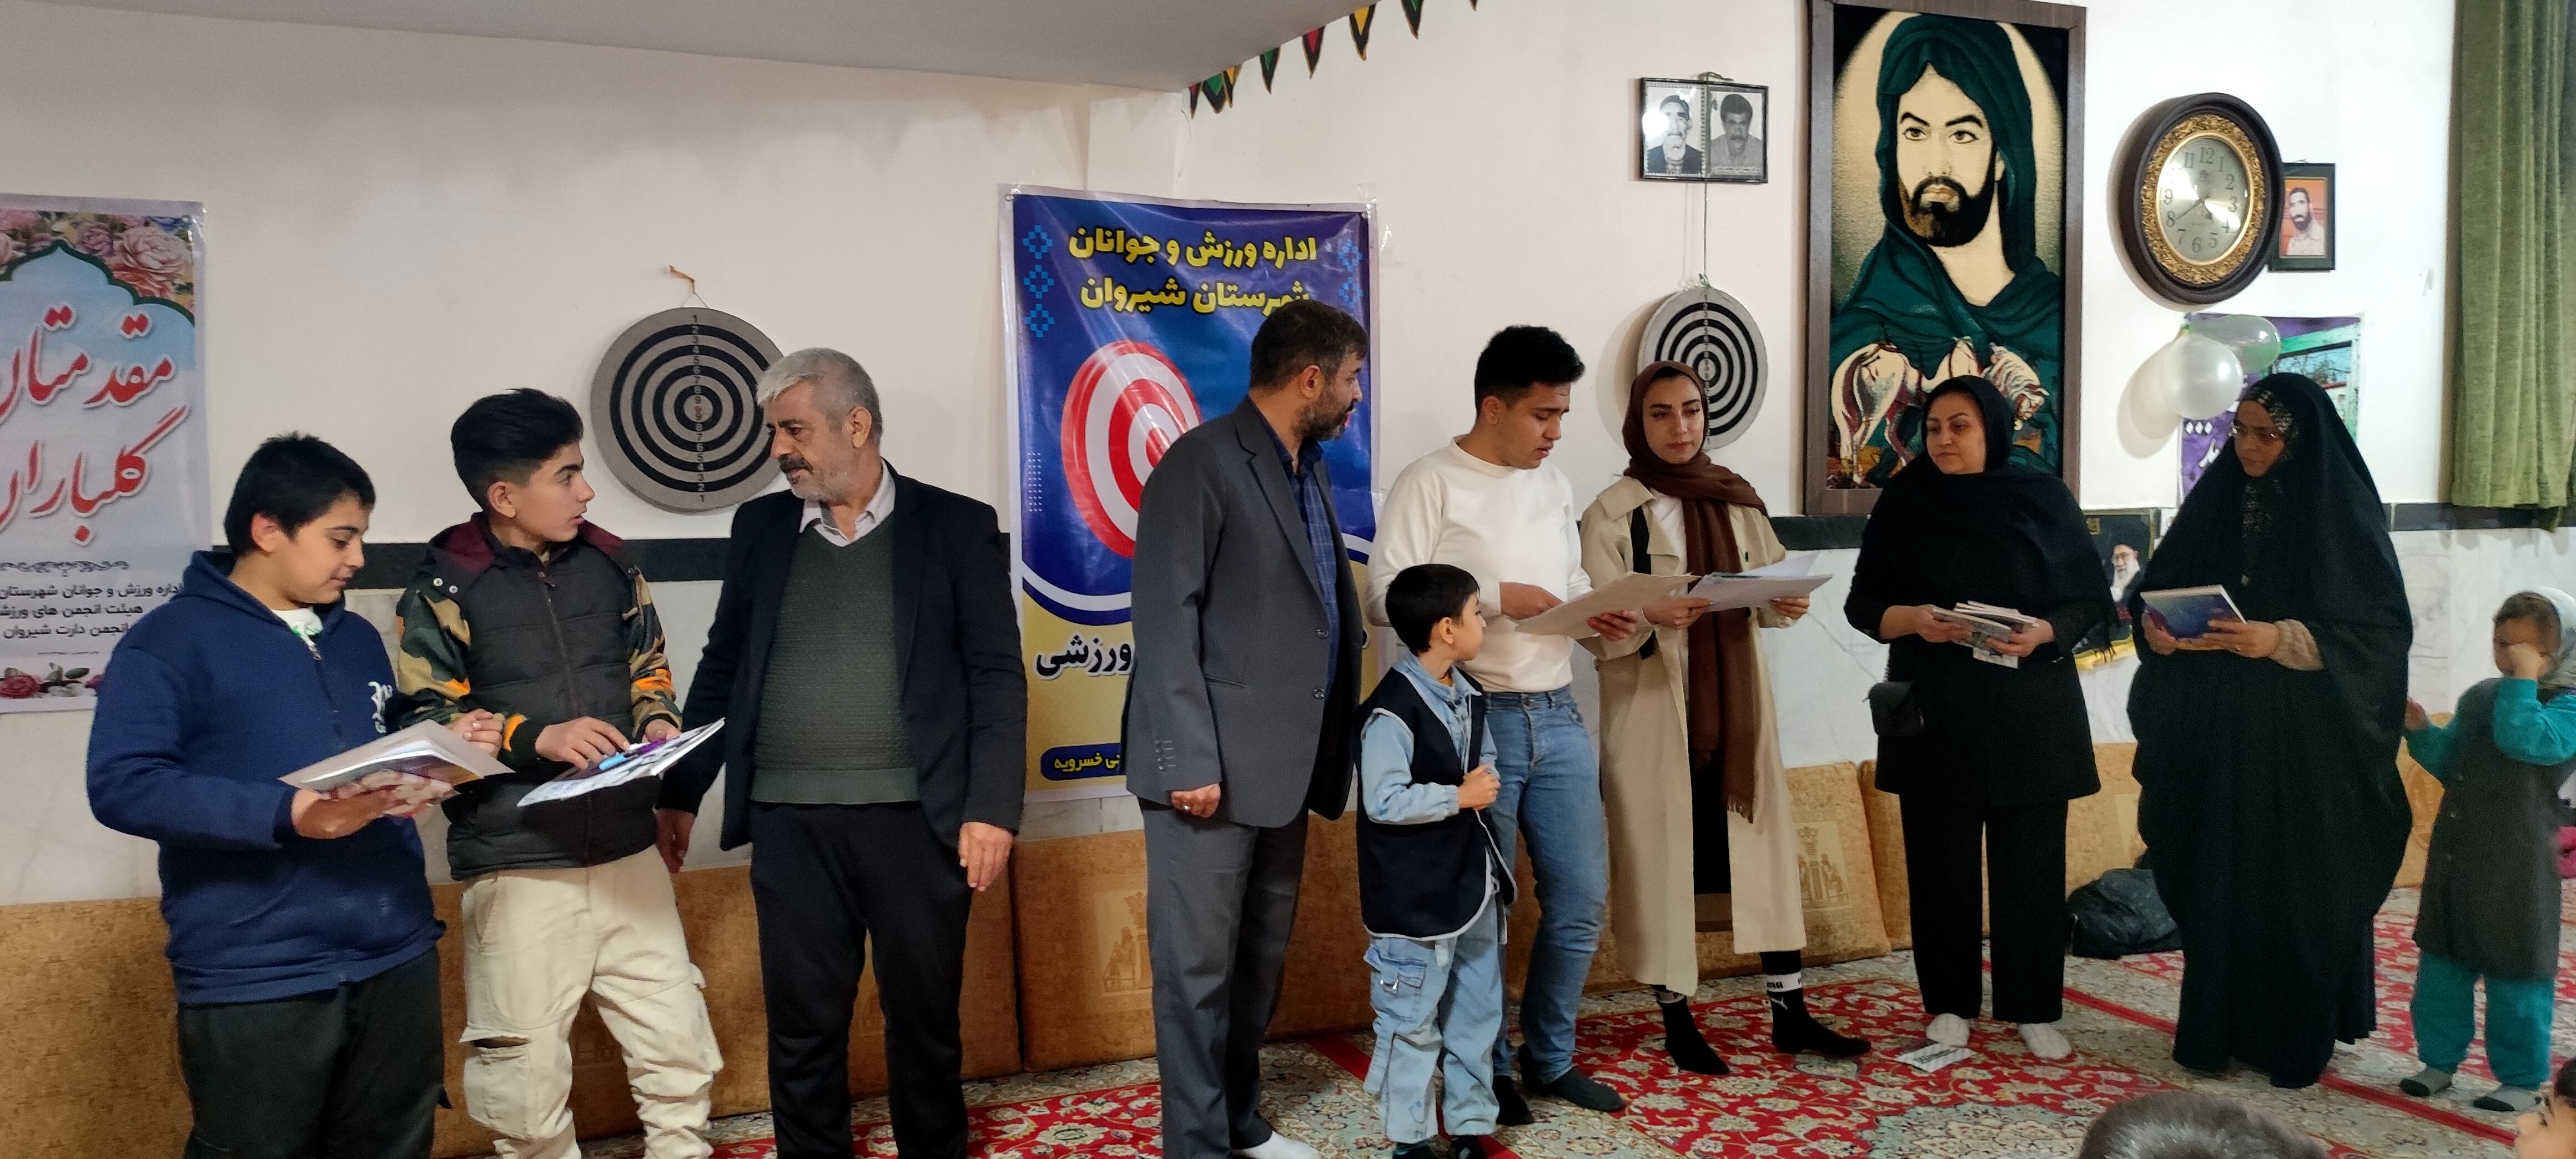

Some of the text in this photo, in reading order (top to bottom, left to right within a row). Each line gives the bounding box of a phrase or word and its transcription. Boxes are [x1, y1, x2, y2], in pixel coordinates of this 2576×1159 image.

[2200, 147, 2214, 164] 12
[2218, 157, 2224, 172] 1
[2226, 174, 2235, 190] 2
[2164, 189, 2173, 205] 9
[2228, 196, 2237, 212] 3
[2166, 210, 2176, 227] 8
[2222, 219, 2230, 233] 4
[2177, 228, 2186, 245] 7
[2208, 232, 2218, 249] 5
[1069, 227, 1317, 269] اداره ورزش و جوانان
[2192, 237, 2201, 253] 6
[1081, 277, 1186, 313] شیروان
[693, 315, 697, 323] 1
[692, 325, 699, 334] 2
[693, 356, 699, 364] 5
[693, 366, 701, 374] 6
[695, 396, 701, 404] 9
[697, 443, 703, 451] 6
[697, 453, 703, 461] 5
[700, 495, 704, 503] 1
[62, 584, 103, 598] جوانان
[106, 587, 114, 597] و
[118, 583, 153, 597] ورزش
[0, 604, 28, 619] ورزش
[33, 604, 58, 618] های
[63, 603, 101, 618] انجمن
[3, 623, 52, 639] شیروان
[56, 623, 85, 638] دارت
[1036, 634, 1131, 677] ورزشی
[1054, 752, 1103, 772] خسرویه
